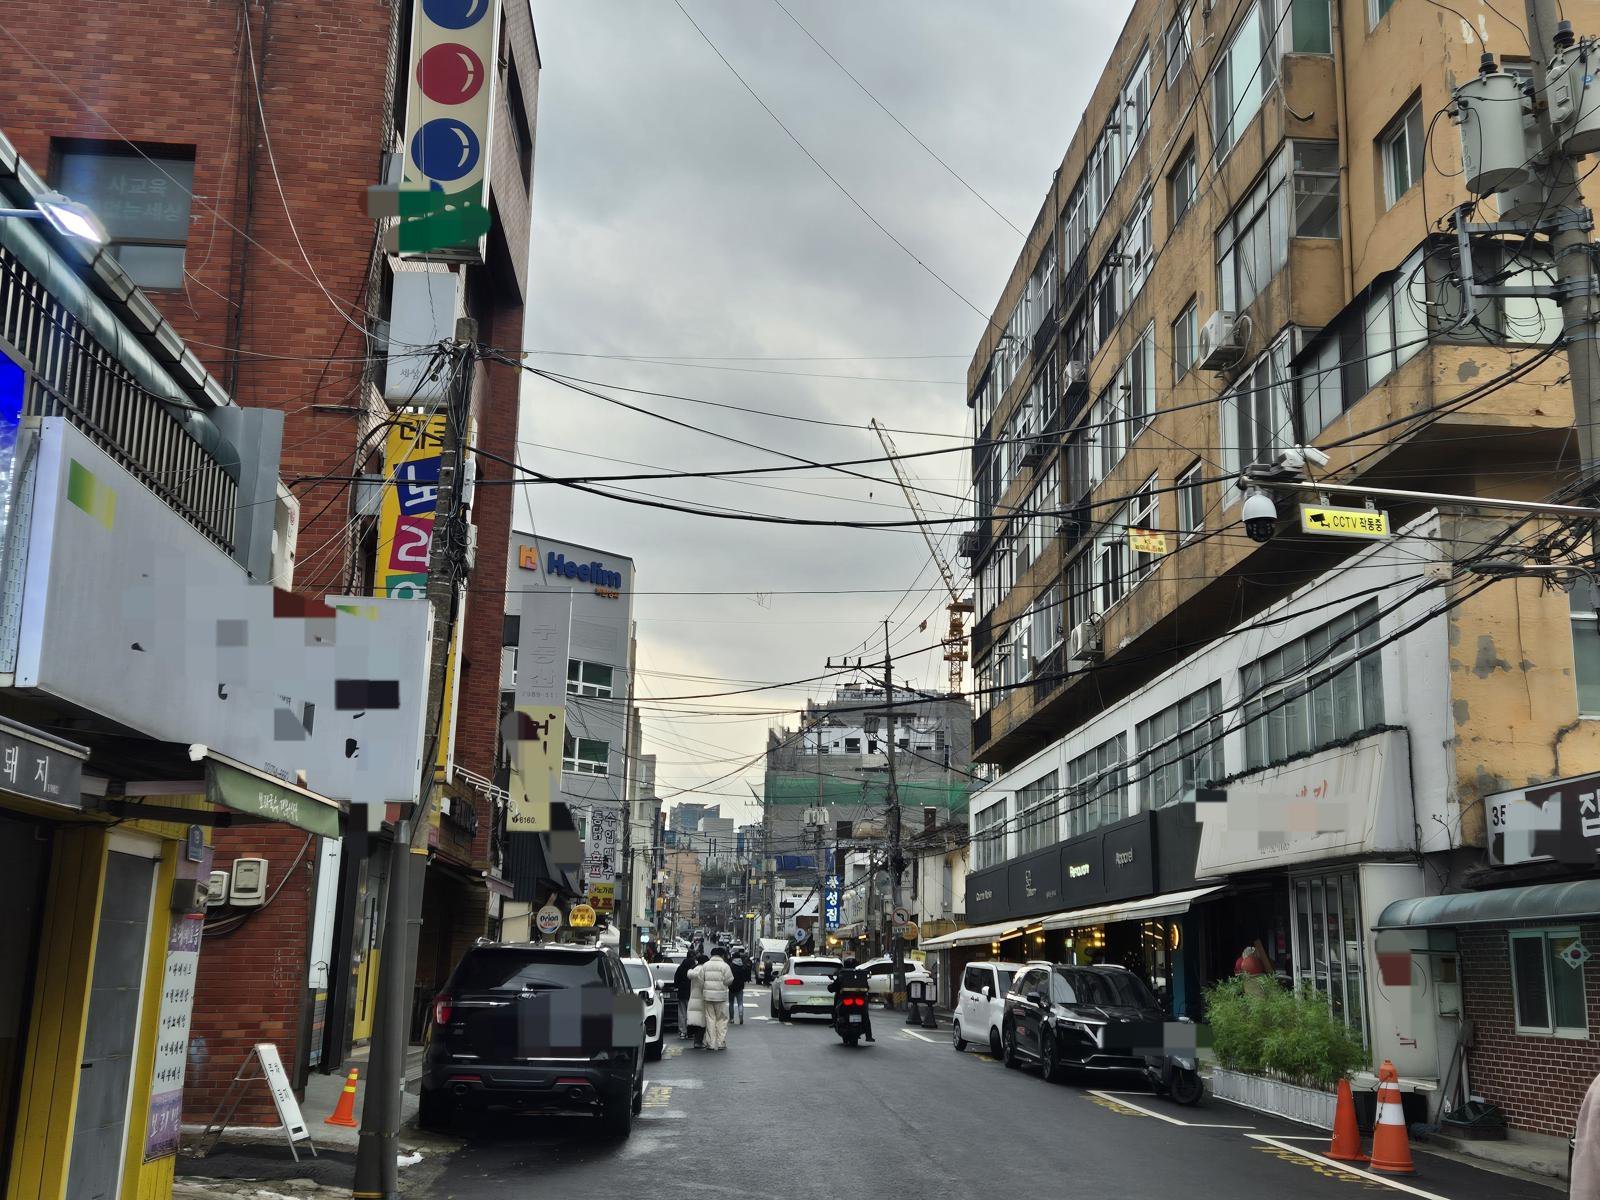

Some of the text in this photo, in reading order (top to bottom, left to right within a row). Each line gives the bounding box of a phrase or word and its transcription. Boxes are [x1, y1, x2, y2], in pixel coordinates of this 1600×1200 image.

[1332, 515, 1383, 532] CCTV 작동중
[547, 551, 621, 588] Heelim
